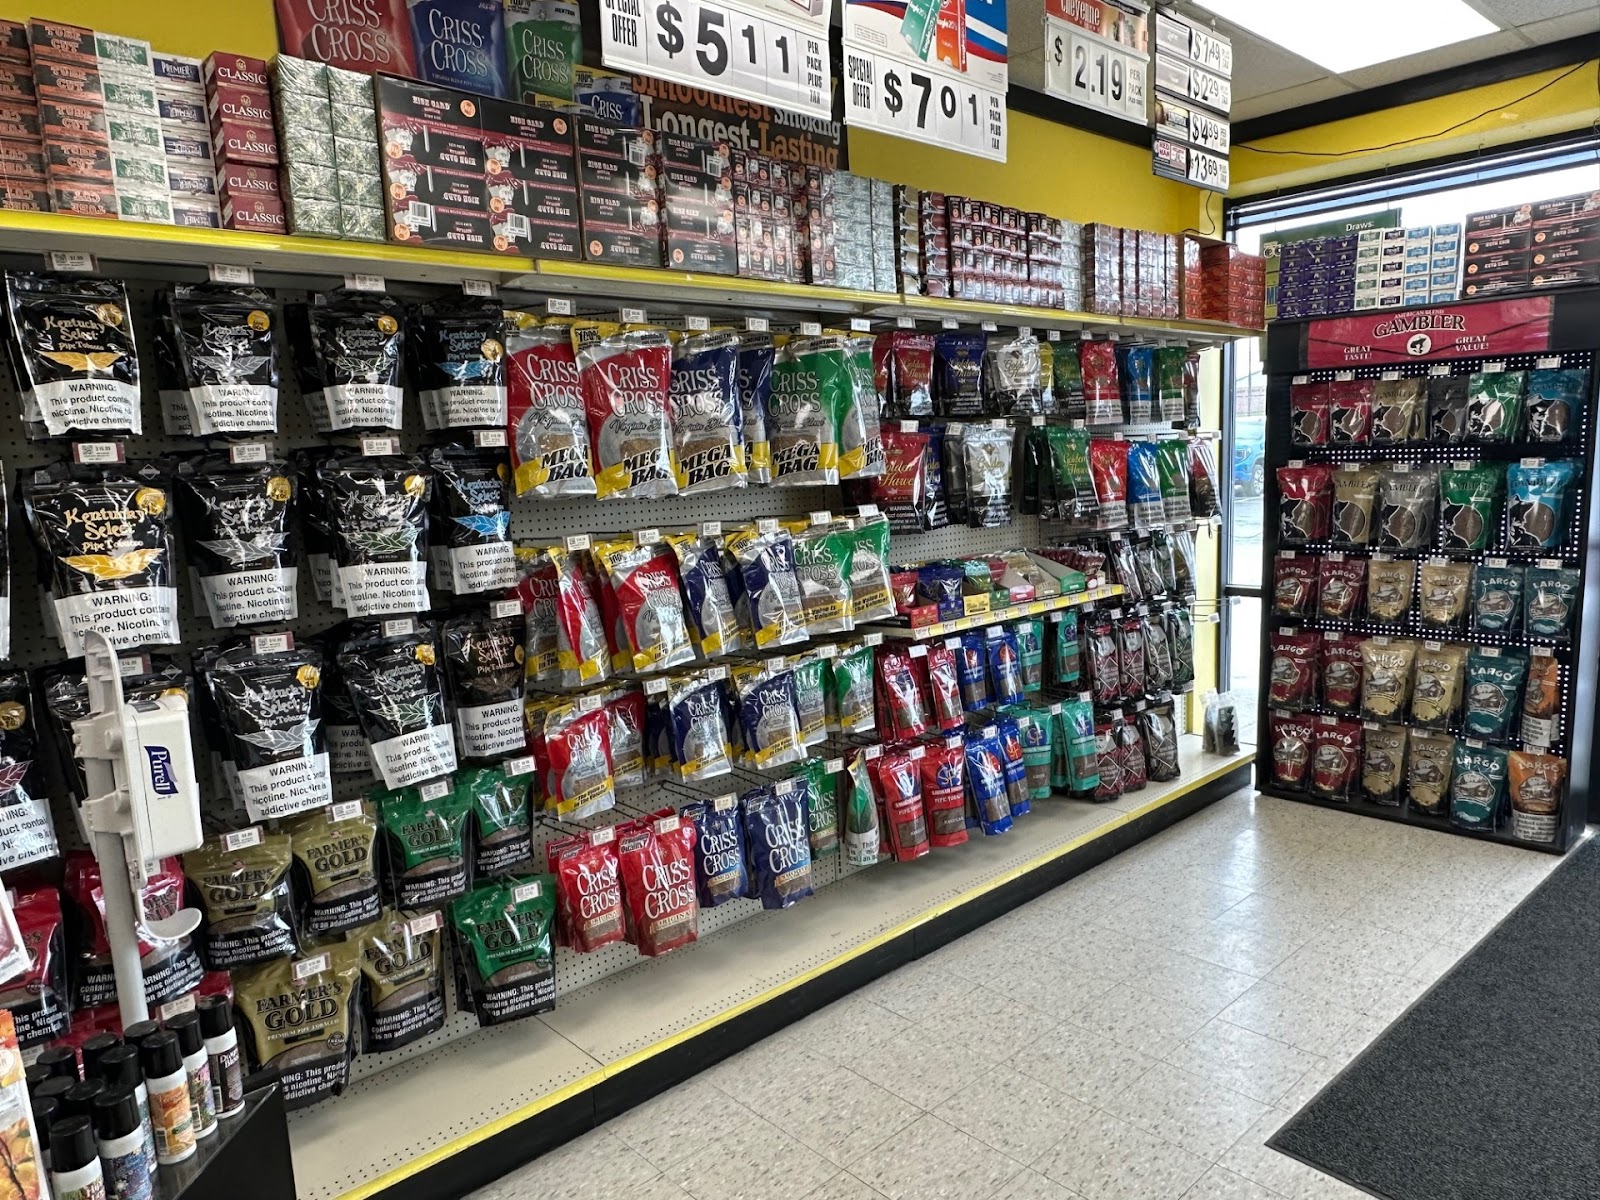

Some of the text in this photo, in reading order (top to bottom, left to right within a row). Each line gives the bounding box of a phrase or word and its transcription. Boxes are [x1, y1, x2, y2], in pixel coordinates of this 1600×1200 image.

[612, 13, 638, 47] OFFER
[311, 23, 391, 64] CROSS
[808, 40, 820, 55] PER
[431, 40, 489, 77] CROSS
[807, 56, 823, 71] PACK
[218, 66, 268, 85] CLASSIC
[522, 56, 570, 85] CROSS
[848, 55, 873, 85] SPECIAL
[1129, 68, 1141, 81] PER
[808, 73, 823, 88] PLUS
[810, 90, 821, 104] TAX
[852, 82, 871, 109] OFFER
[990, 96, 999, 108] PER
[222, 102, 272, 120] CLASSIC
[990, 109, 1002, 123] PACK
[990, 123, 1002, 136] PLUS
[228, 137, 278, 155] CLASSIC
[229, 176, 278, 192] CLASSIC
[236, 209, 285, 226] CLASSIC
[1394, 308, 1445, 319] AMERICAN BLEND
[44, 315, 105, 334] Kentucky
[1373, 313, 1466, 339] GAMBLER
[60, 328, 99, 342] Select
[439, 330, 486, 343] Kentucky
[704, 333, 732, 344] SMOOTH
[1456, 335, 1489, 344] GREAT
[449, 340, 480, 351] Select
[1344, 346, 1372, 355] GREAT
[1456, 343, 1490, 352] VALUE!
[1344, 353, 1373, 362] TASTE!
[69, 383, 117, 393] WARNING:
[530, 380, 584, 410] CROSS
[50, 394, 106, 406] This product
[219, 399, 250, 408] product
[610, 390, 665, 418] CROSS
[768, 392, 822, 417] CROSS
[236, 409, 268, 417] Nicotine
[541, 445, 588, 469] MEGA
[680, 443, 732, 474] MEGA
[771, 442, 820, 467] MEGA
[547, 464, 589, 484] BAG
[686, 461, 731, 486] BAG
[777, 457, 819, 478] BAG
[64, 508, 146, 527] Kentucky
[84, 522, 136, 541] Select
[82, 541, 105, 553] Pipe
[365, 566, 411, 576] WARNING:
[459, 561, 474, 570] This
[1280, 567, 1308, 576] LARGO
[227, 574, 277, 586] WARNING:
[1323, 569, 1356, 580] LARGO
[365, 579, 398, 590] product
[1482, 577, 1518, 588] LARGO
[1533, 580, 1571, 591] LARGO
[92, 592, 152, 607] WARNING:
[228, 588, 265, 599] product
[382, 589, 416, 598] Nicotine
[70, 609, 137, 625] This product
[1325, 647, 1362, 658] LARGO
[1418, 658, 1451, 671] LARGO
[1471, 666, 1514, 681] LARGO
[259, 700, 302, 718] Select
[481, 705, 519, 718] WARNING:
[482, 718, 511, 729] product
[1316, 731, 1352, 745] LARGO
[385, 754, 402, 763] This
[1456, 755, 1500, 771] LARGO
[151, 750, 171, 795] Purell
[1519, 761, 1559, 773] LARGO
[249, 776, 306, 794] This product
[260, 803, 299, 815] addictive
[307, 834, 370, 860] FARMER'S
[315, 847, 367, 873] GOLD
[703, 846, 740, 876] CROSS
[769, 838, 810, 873] CROSS
[437, 876, 450, 885] This
[208, 881, 270, 902] GOLD
[314, 899, 362, 916] WARNING: This
[580, 885, 620, 919] CROSS
[645, 880, 695, 920] CROSS
[244, 936, 259, 945] This
[484, 922, 540, 950] GOLD
[374, 941, 431, 976] GOLD
[520, 984, 534, 993] This
[256, 982, 343, 1013] FARMER'S
[264, 998, 340, 1031] GOLD
[376, 1010, 413, 1025] WARNING:
[267, 1031, 296, 1041] PREMIUM
[305, 1067, 322, 1078] This
